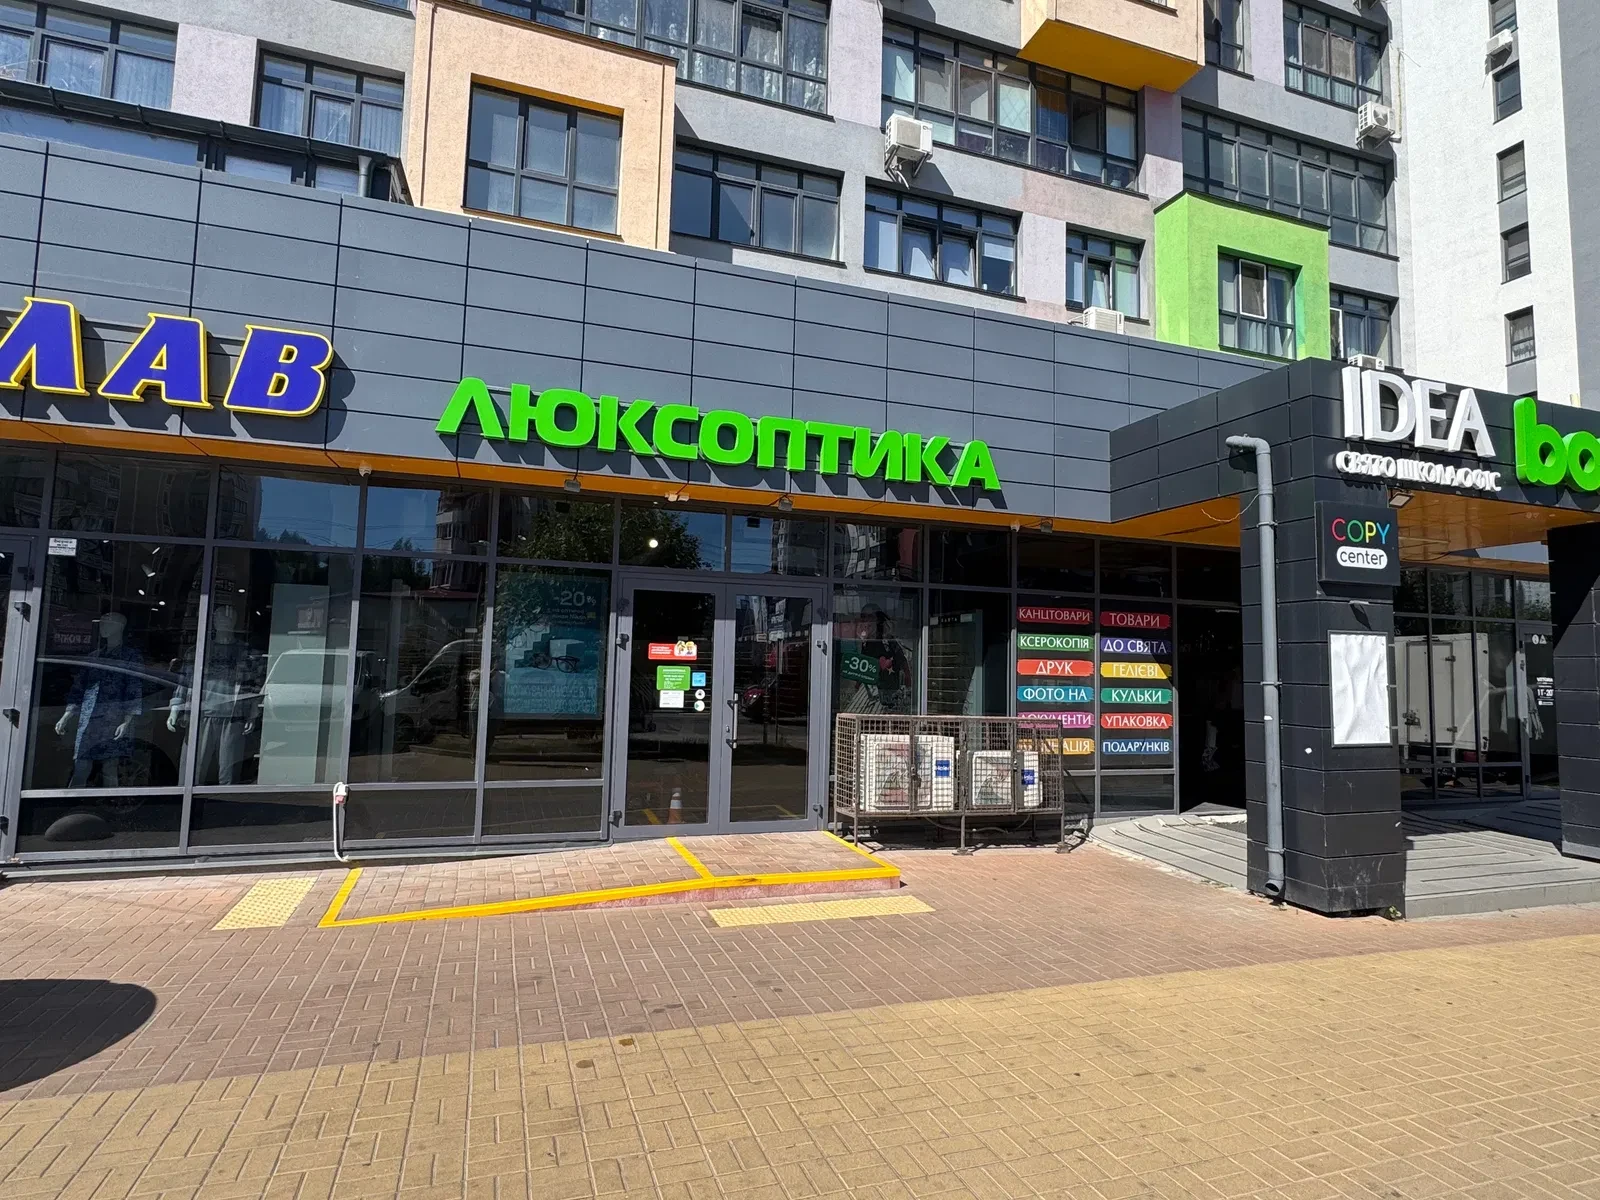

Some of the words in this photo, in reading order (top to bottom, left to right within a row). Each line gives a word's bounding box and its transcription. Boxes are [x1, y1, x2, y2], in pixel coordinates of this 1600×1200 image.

[436, 377, 1002, 490] ЛЮКСОПТИКА
[1341, 366, 1496, 458] IDEA
[1513, 397, 1600, 493] bo
[1331, 517, 1391, 545] COPY
[1340, 548, 1385, 567] center
[1019, 608, 1090, 622] КАНЦТОВАРИ
[1109, 612, 1160, 627] ТОВАРИ
[1020, 636, 1090, 649] КСЕРОКОПІЯ
[1103, 639, 1124, 652] ДО
[1127, 640, 1167, 654] СВЯТА
[844, 656, 877, 673] -30%
[1036, 661, 1074, 675] ДРУК
[1112, 663, 1158, 677] ГЕЛІЄВІ
[1023, 687, 1065, 701] ФОТО
[1068, 688, 1087, 701] НА
[1111, 689, 1162, 703] КУЛЬКИ
[1105, 714, 1167, 728] УПАКОВКА
[1102, 740, 1170, 753] ПОДАРУНКІВ
